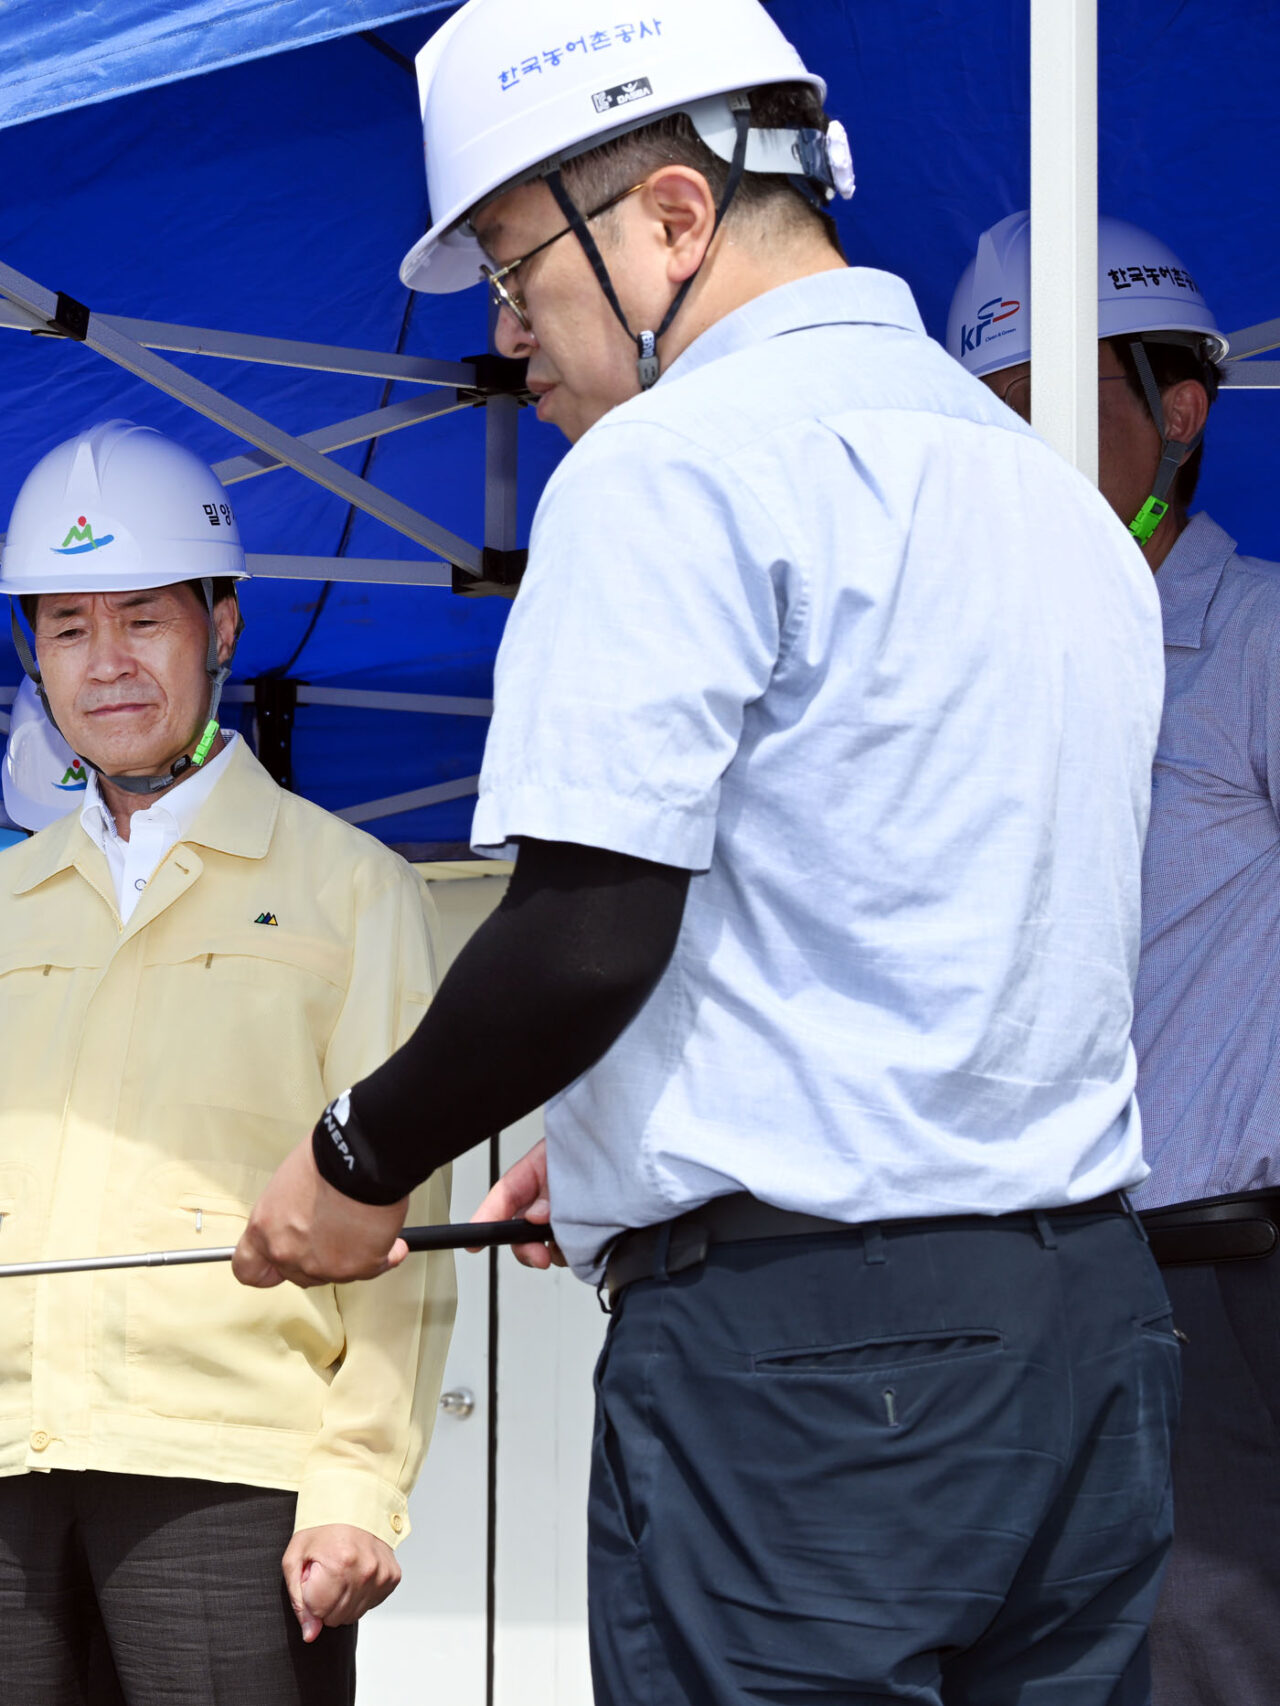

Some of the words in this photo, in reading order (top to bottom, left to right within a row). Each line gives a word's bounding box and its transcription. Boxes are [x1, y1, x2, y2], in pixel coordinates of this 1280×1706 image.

[498, 18, 662, 91] 한국농어촌공사
[1107, 264, 1200, 293] 한국농어촌공
[202, 503, 235, 526] 밀양
